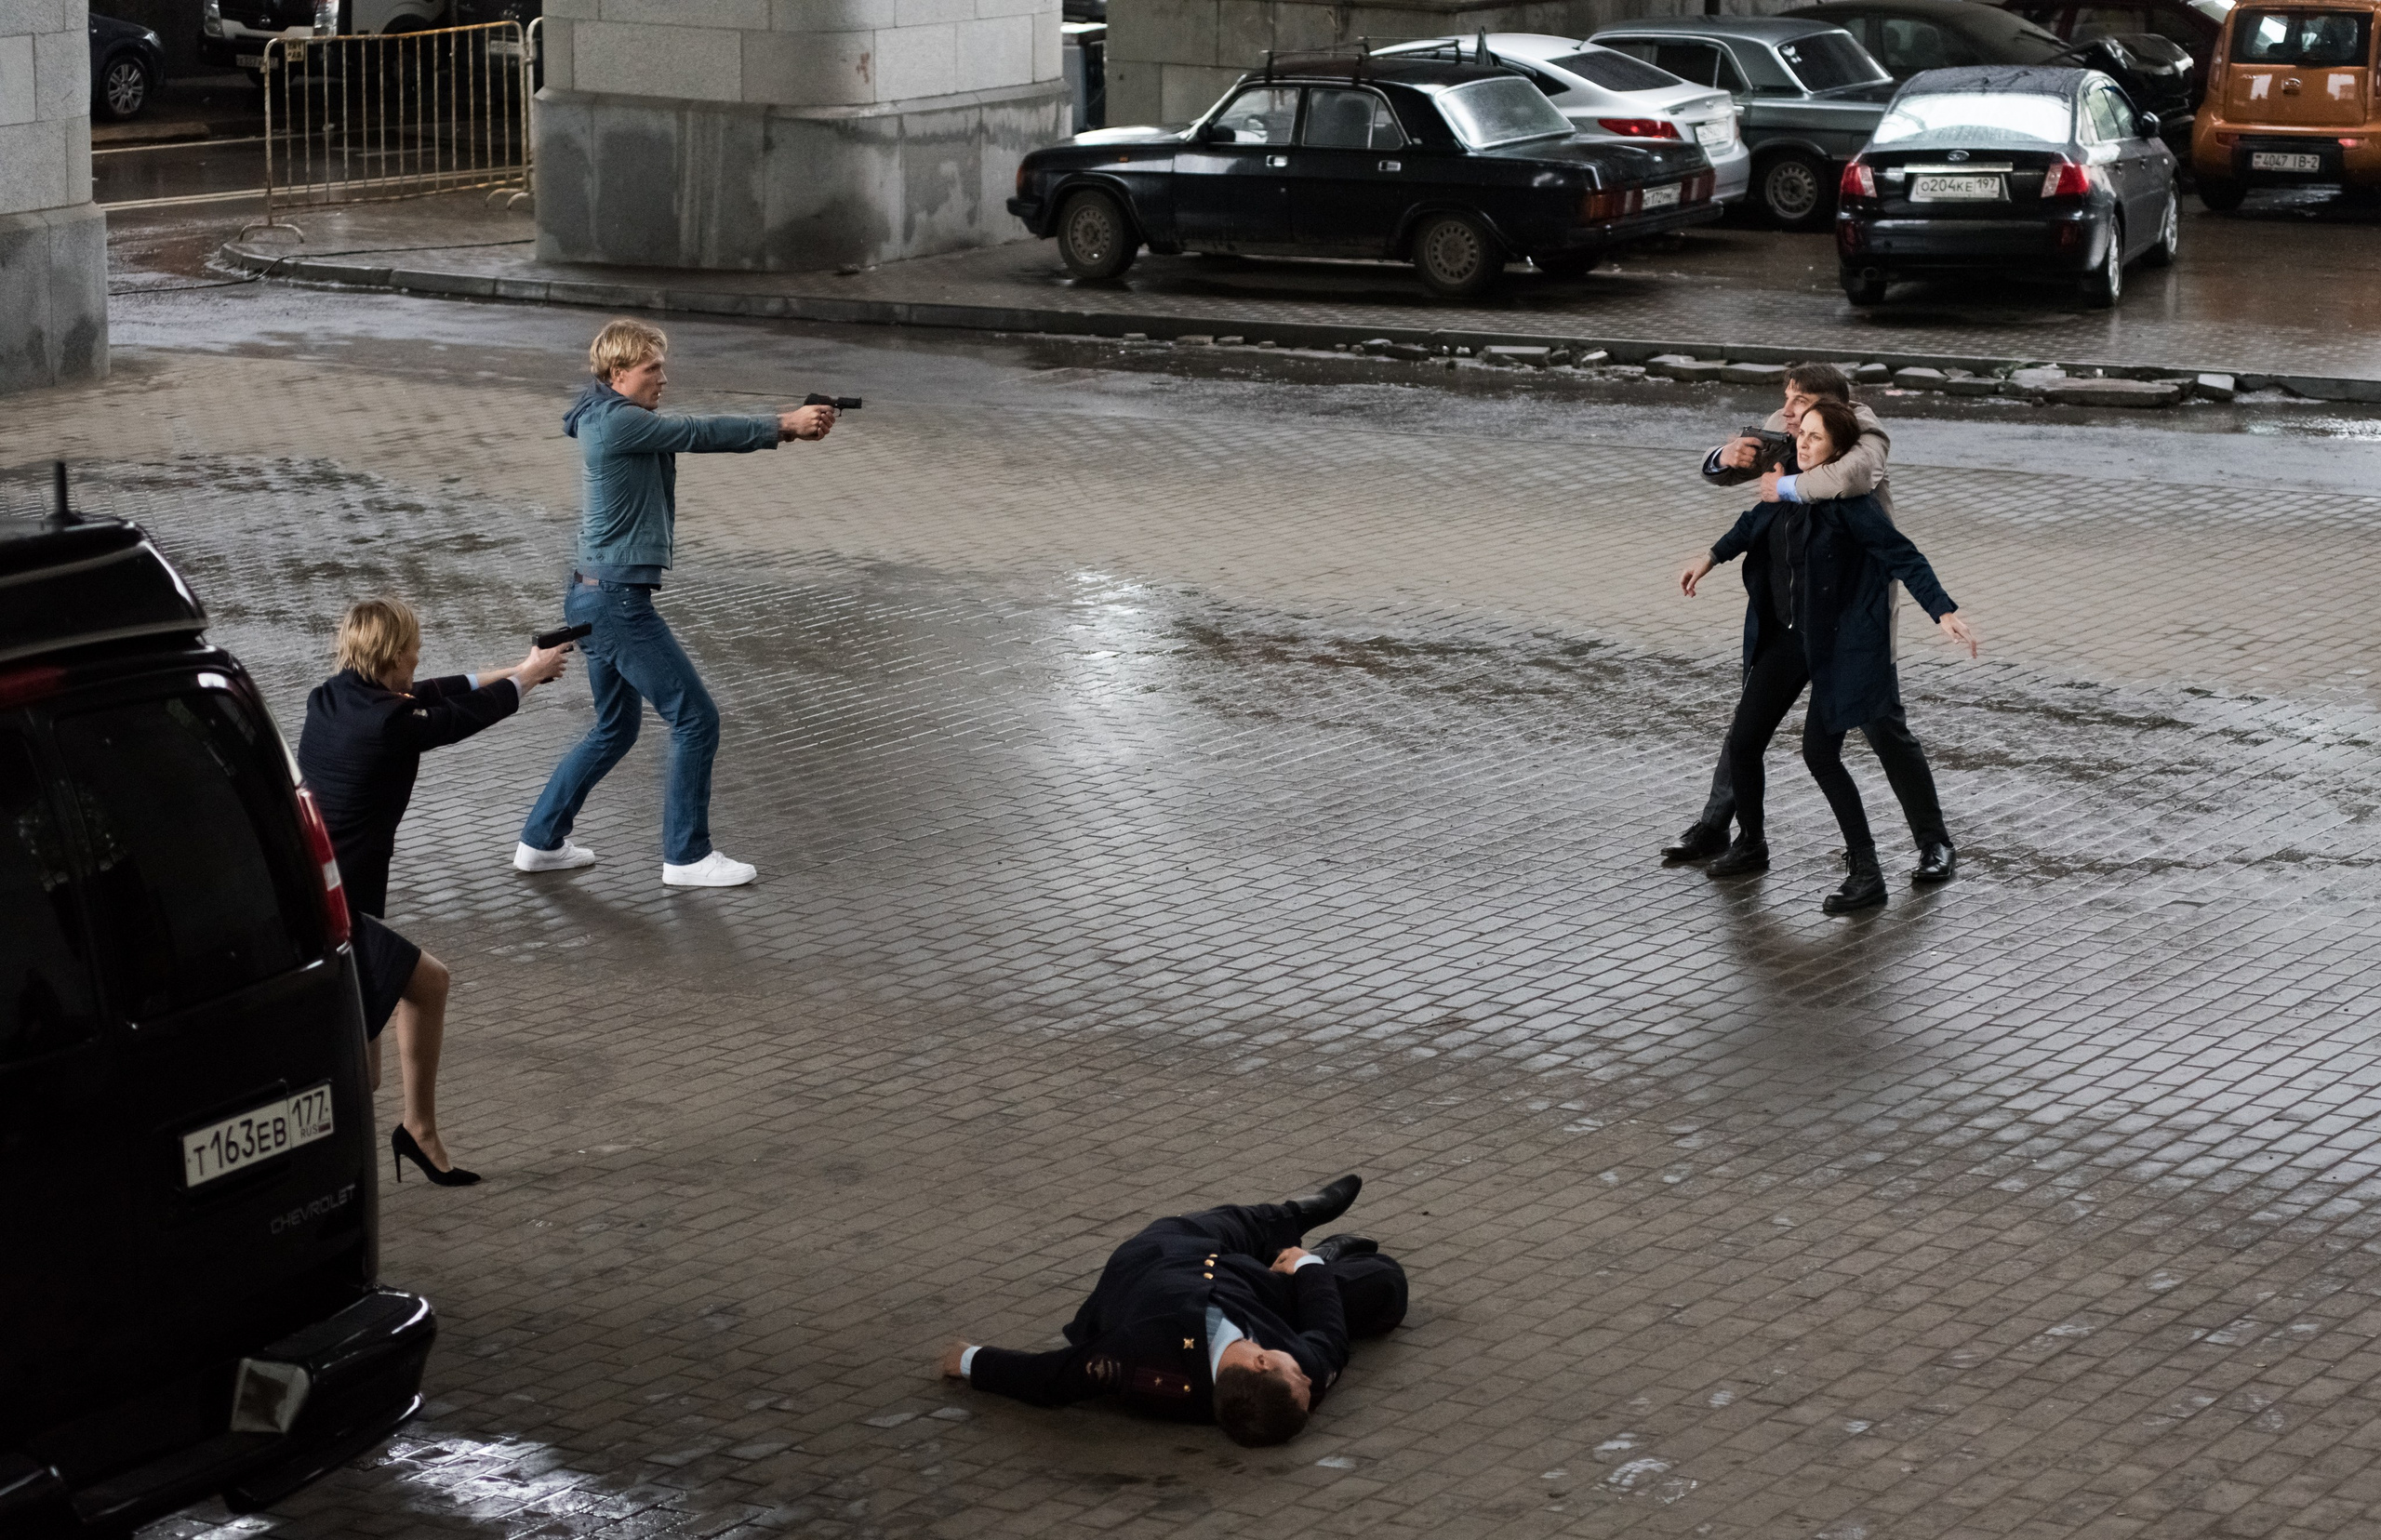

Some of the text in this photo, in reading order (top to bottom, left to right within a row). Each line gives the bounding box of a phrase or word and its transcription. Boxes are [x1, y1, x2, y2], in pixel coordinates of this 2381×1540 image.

[2263, 154, 2288, 166] 4047
[1921, 178, 1996, 192] O204KE 197
[193, 1090, 325, 1176] T163EB 177
[300, 1123, 318, 1139] RUS
[271, 1183, 355, 1234] CHEVROLET
